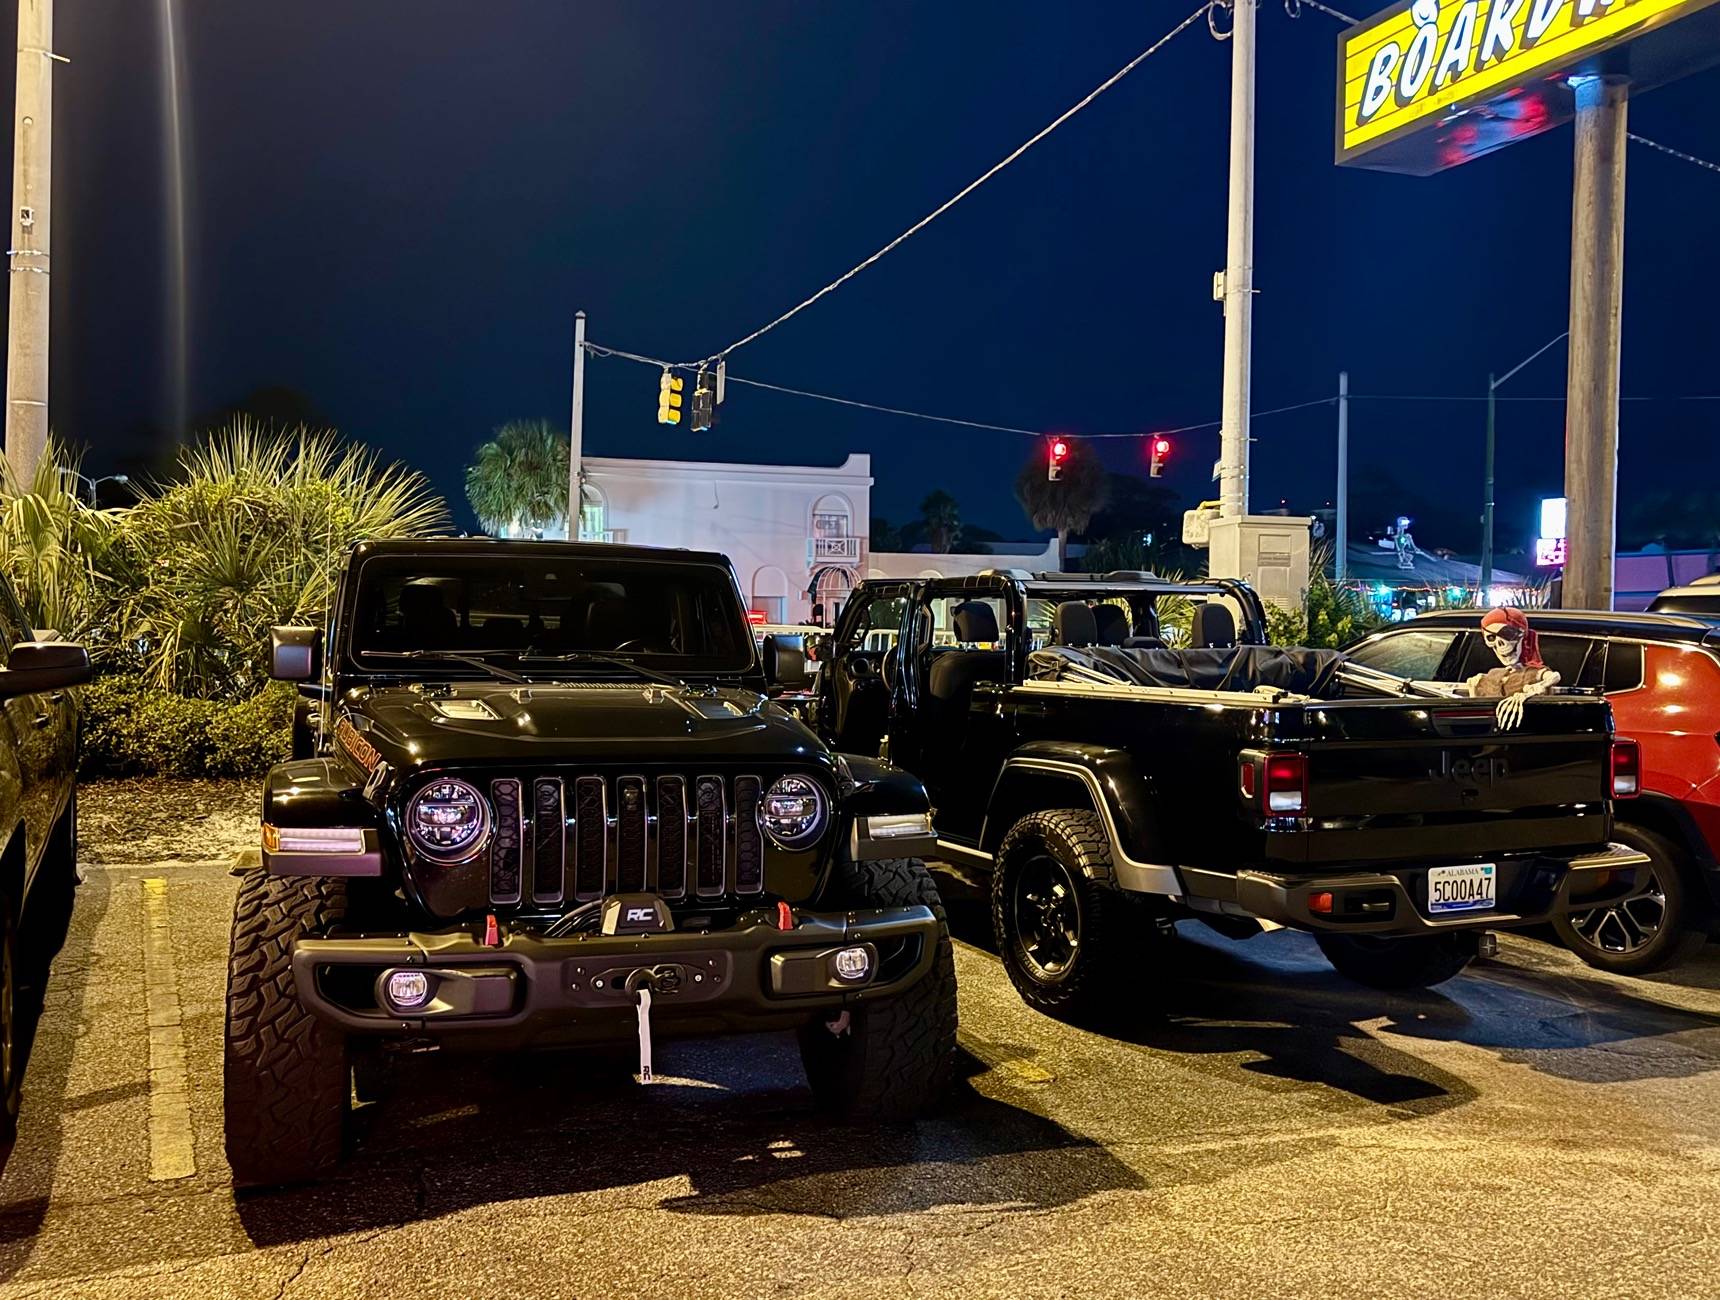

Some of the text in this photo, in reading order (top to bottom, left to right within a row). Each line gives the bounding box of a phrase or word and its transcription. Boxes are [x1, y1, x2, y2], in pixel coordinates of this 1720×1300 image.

[1359, 0, 1614, 119] BOARD
[1428, 750, 1509, 787] Jeep
[1446, 868, 1479, 877] ALABAMA
[627, 908, 654, 921] RC
[643, 1065, 651, 1081] RC
